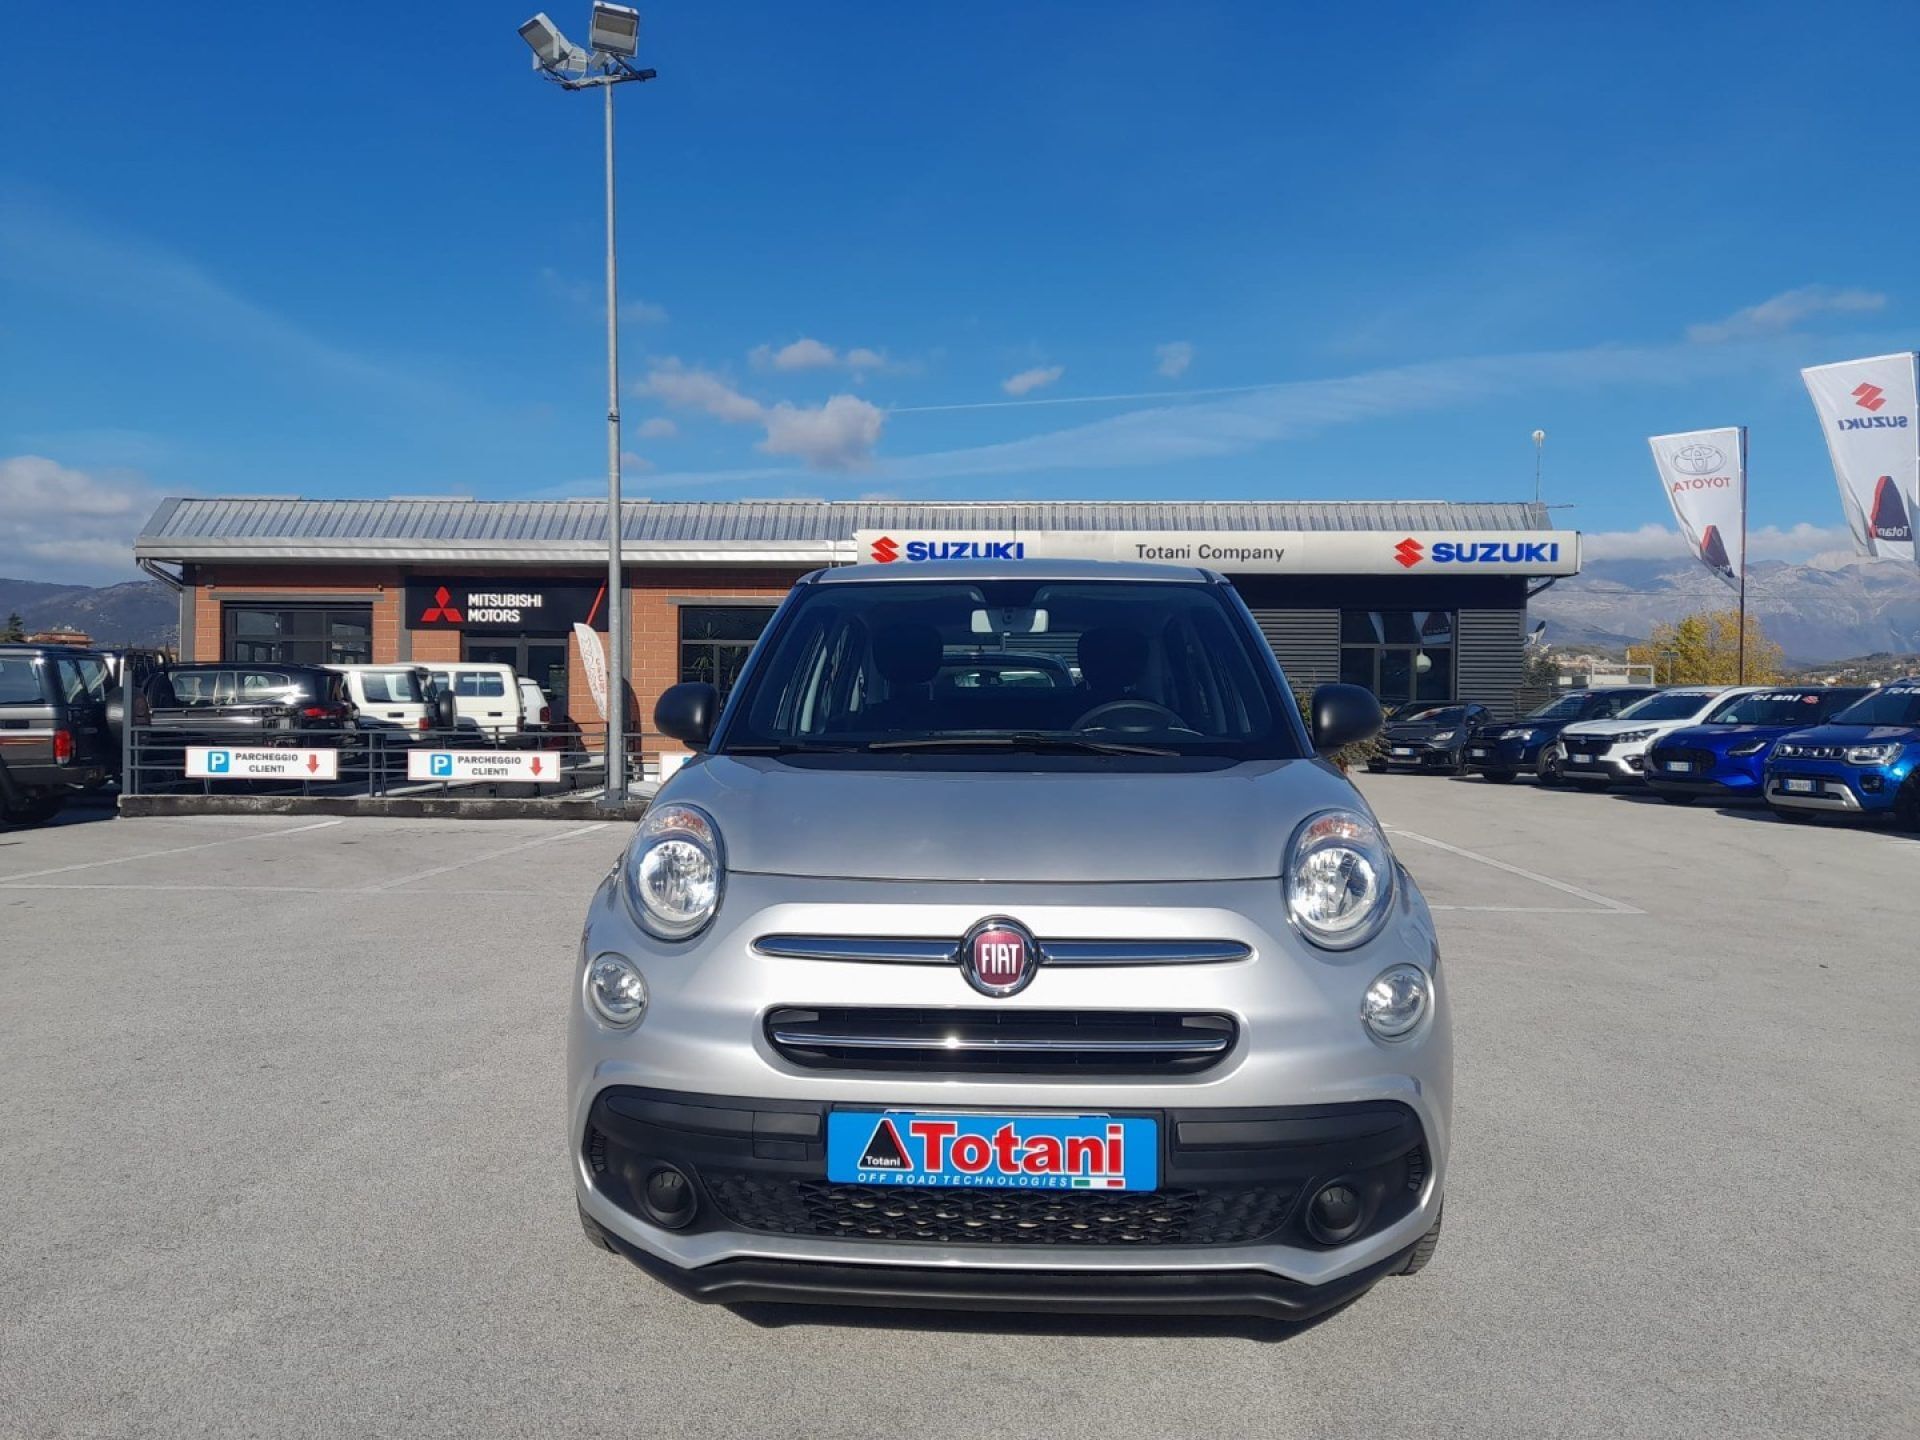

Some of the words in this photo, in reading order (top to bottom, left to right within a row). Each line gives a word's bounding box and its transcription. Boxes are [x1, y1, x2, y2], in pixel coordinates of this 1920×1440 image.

[906, 541, 1024, 561] SUZUKI
[1136, 544, 1191, 559] Totani
[1198, 544, 1285, 562] Company
[1431, 542, 1558, 563] SUZUKI
[468, 593, 542, 607] MITSUBISHI
[468, 609, 521, 622] MOTORS
[211, 753, 225, 771] P
[235, 753, 298, 761] PARCHEGGIO
[248, 765, 285, 773] CLIENTI
[434, 756, 448, 773] P
[457, 756, 521, 765] PARCHEGGIO
[471, 768, 508, 776] CLIENTI
[981, 943, 1020, 975] FIAT
[909, 1121, 1124, 1176] Totani
[866, 1155, 901, 1167] Totani
[857, 1172, 887, 1183] OFF
[895, 1174, 937, 1185] ROAD
[943, 1175, 1068, 1188] TECHNOLOGIES
